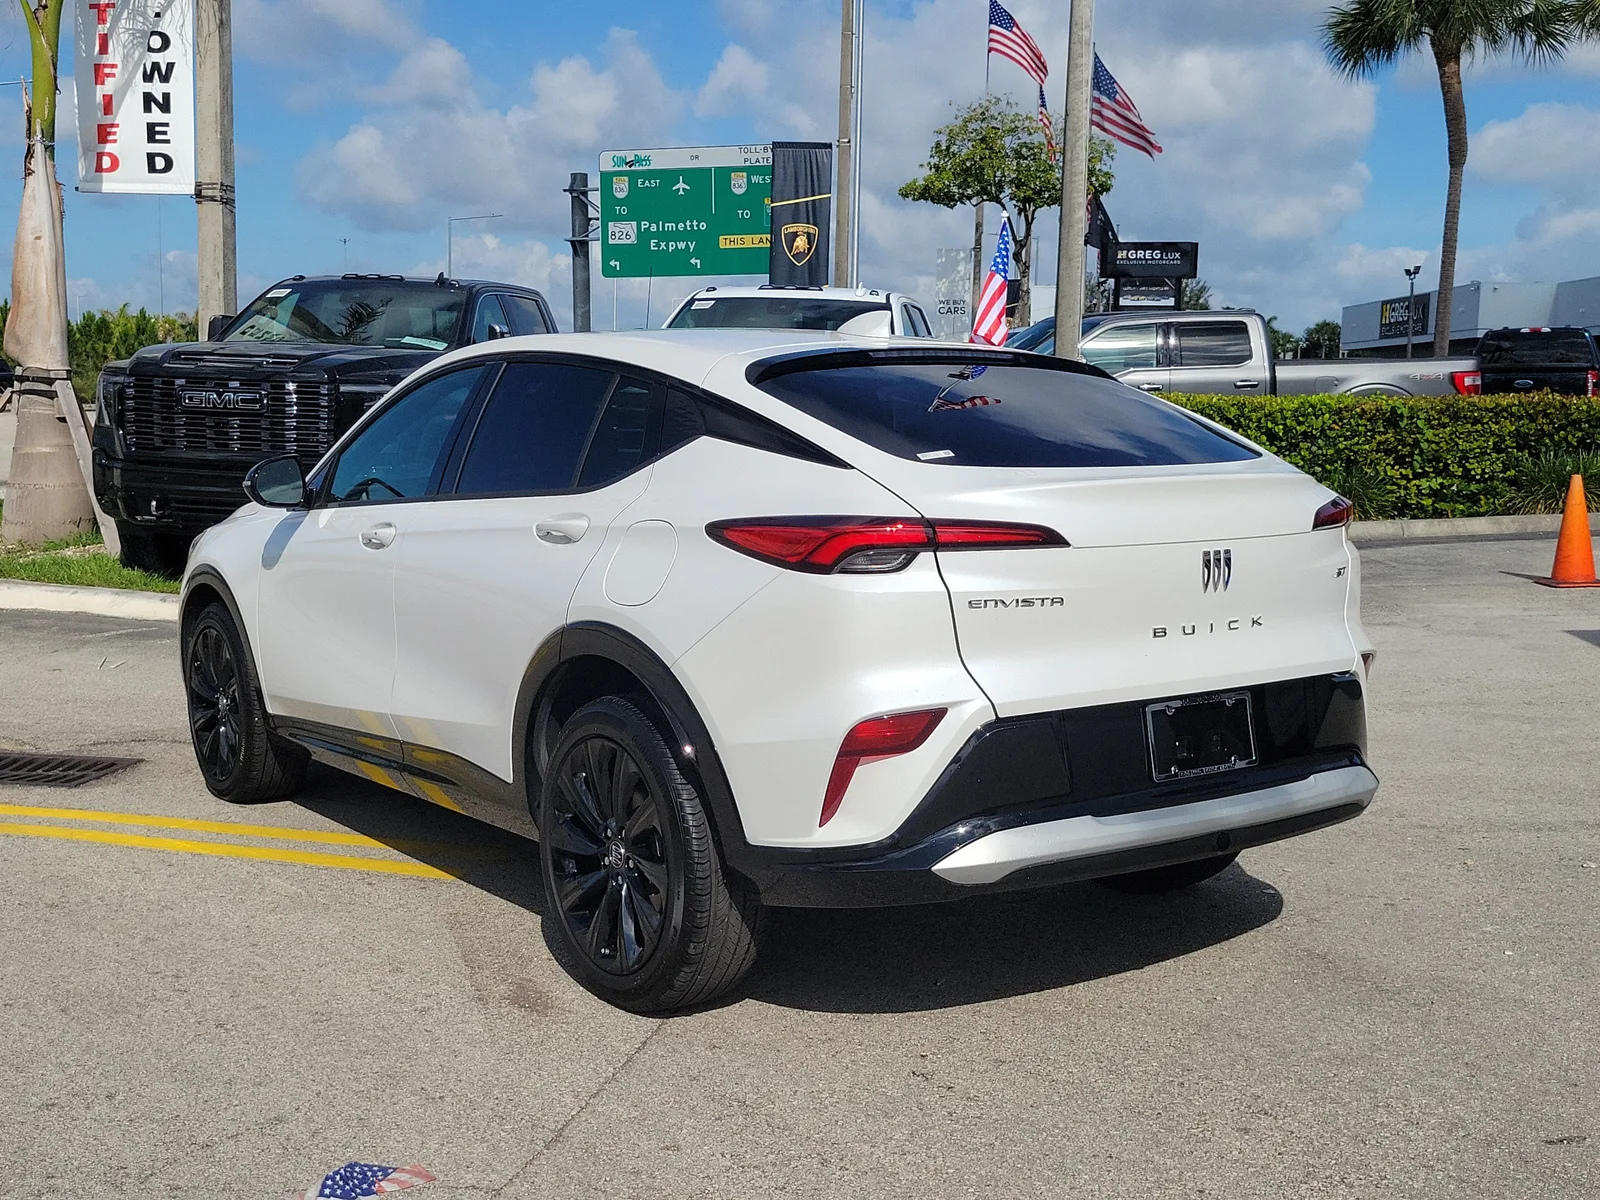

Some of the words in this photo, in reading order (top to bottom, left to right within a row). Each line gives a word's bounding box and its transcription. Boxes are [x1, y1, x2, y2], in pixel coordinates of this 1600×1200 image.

[743, 156, 771, 165] PLATE
[637, 179, 660, 188] EAST
[615, 206, 628, 215] TO
[737, 210, 751, 219] TO
[610, 230, 632, 240] 826
[640, 220, 707, 232] Palmetto
[650, 239, 696, 252] Expwy
[723, 237, 746, 246] THIS
[938, 306, 966, 315] CARS
[181, 390, 261, 409] GMC
[967, 596, 1064, 609] ENVISTA
[1152, 615, 1263, 639] BUICK
